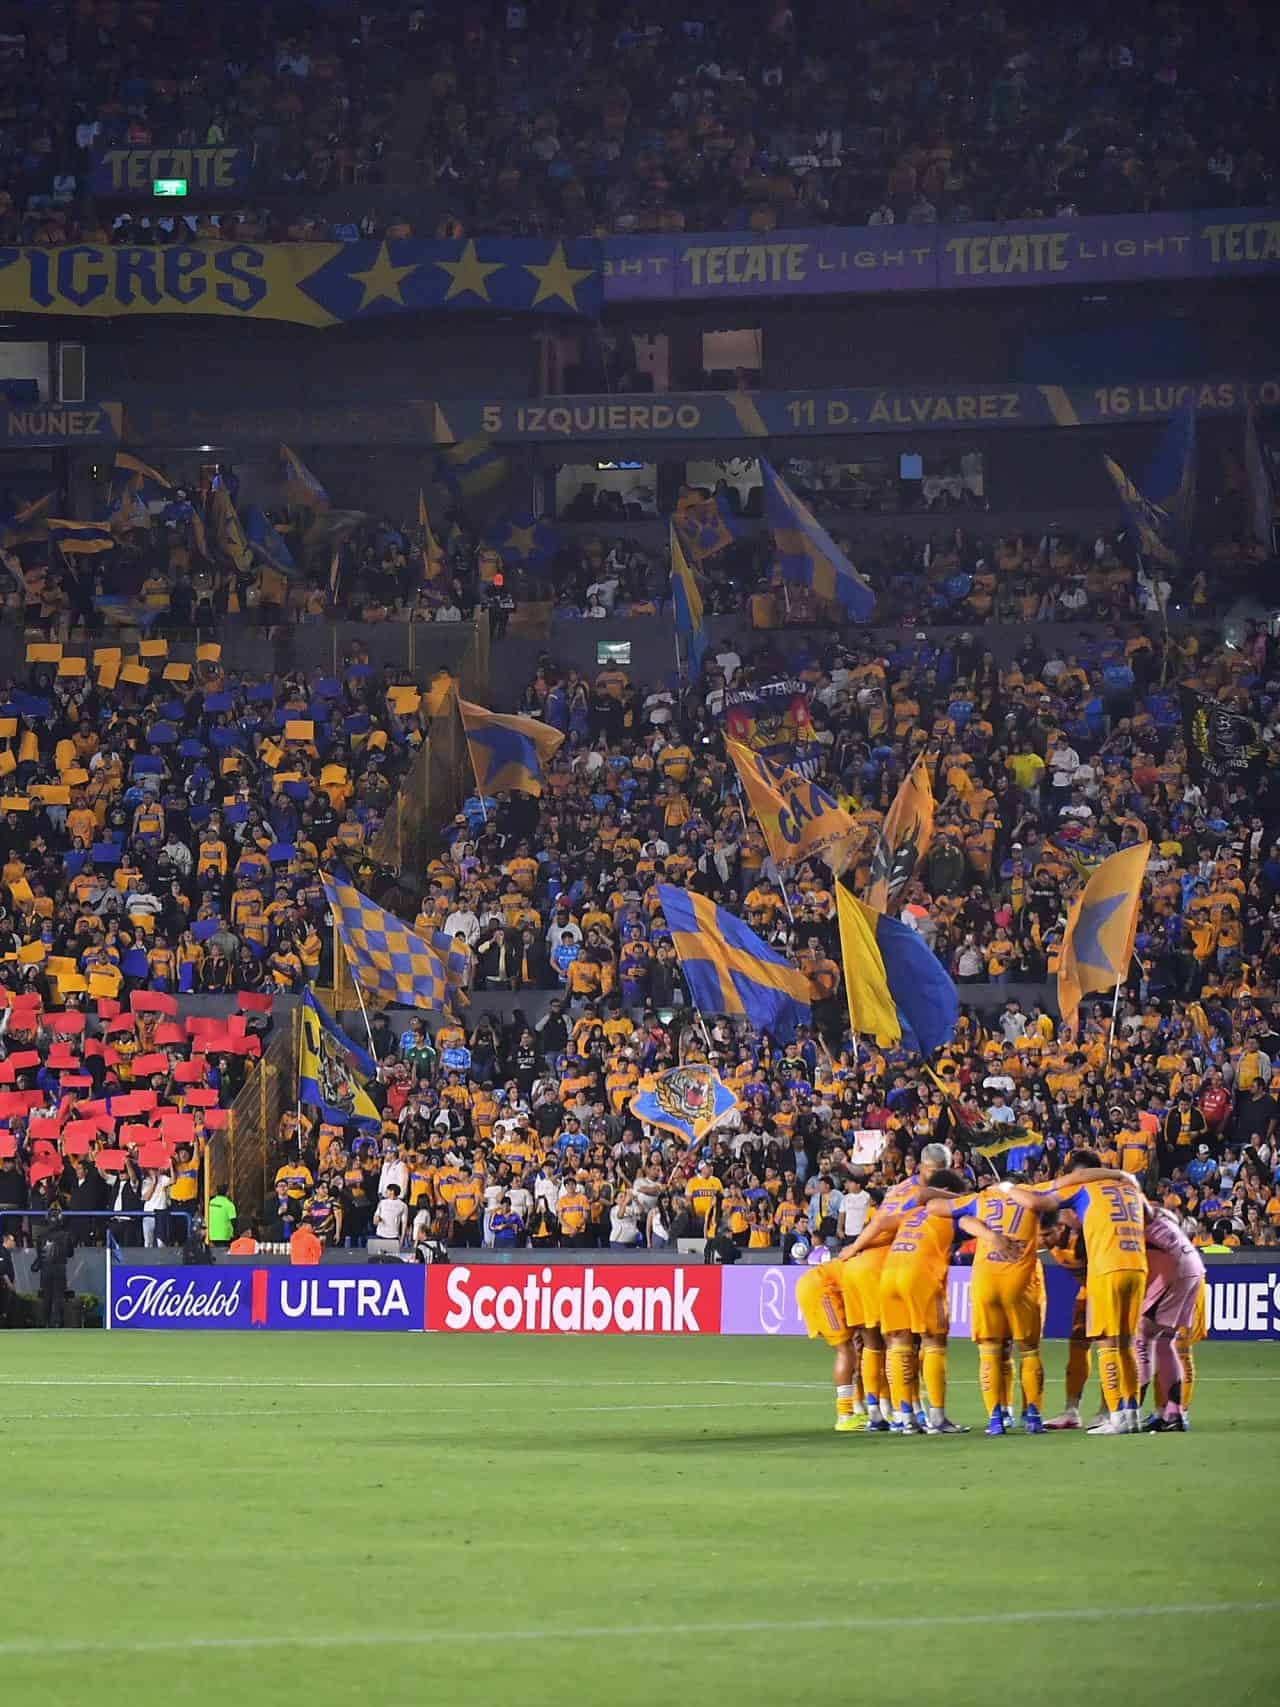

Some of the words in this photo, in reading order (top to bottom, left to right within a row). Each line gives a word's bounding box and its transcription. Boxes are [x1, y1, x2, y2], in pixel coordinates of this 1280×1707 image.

[682, 243, 810, 287] TECATE
[816, 247, 931, 271] LIGHT
[946, 233, 1070, 277] TECATE
[1078, 233, 1191, 260] LIGHT
[481, 405, 504, 433] 5
[516, 403, 701, 434] IZQUIERDO
[786, 401, 816, 429] 11
[827, 398, 861, 425] D.
[869, 390, 1021, 424] ÁLVAREZ
[1094, 387, 1132, 416] 16
[984, 1199, 1025, 1235] 27
[1102, 1186, 1139, 1223] 32
[115, 1274, 241, 1321] Michelob
[280, 1277, 410, 1318] ULTRA
[445, 1266, 700, 1332] Scotiabank
